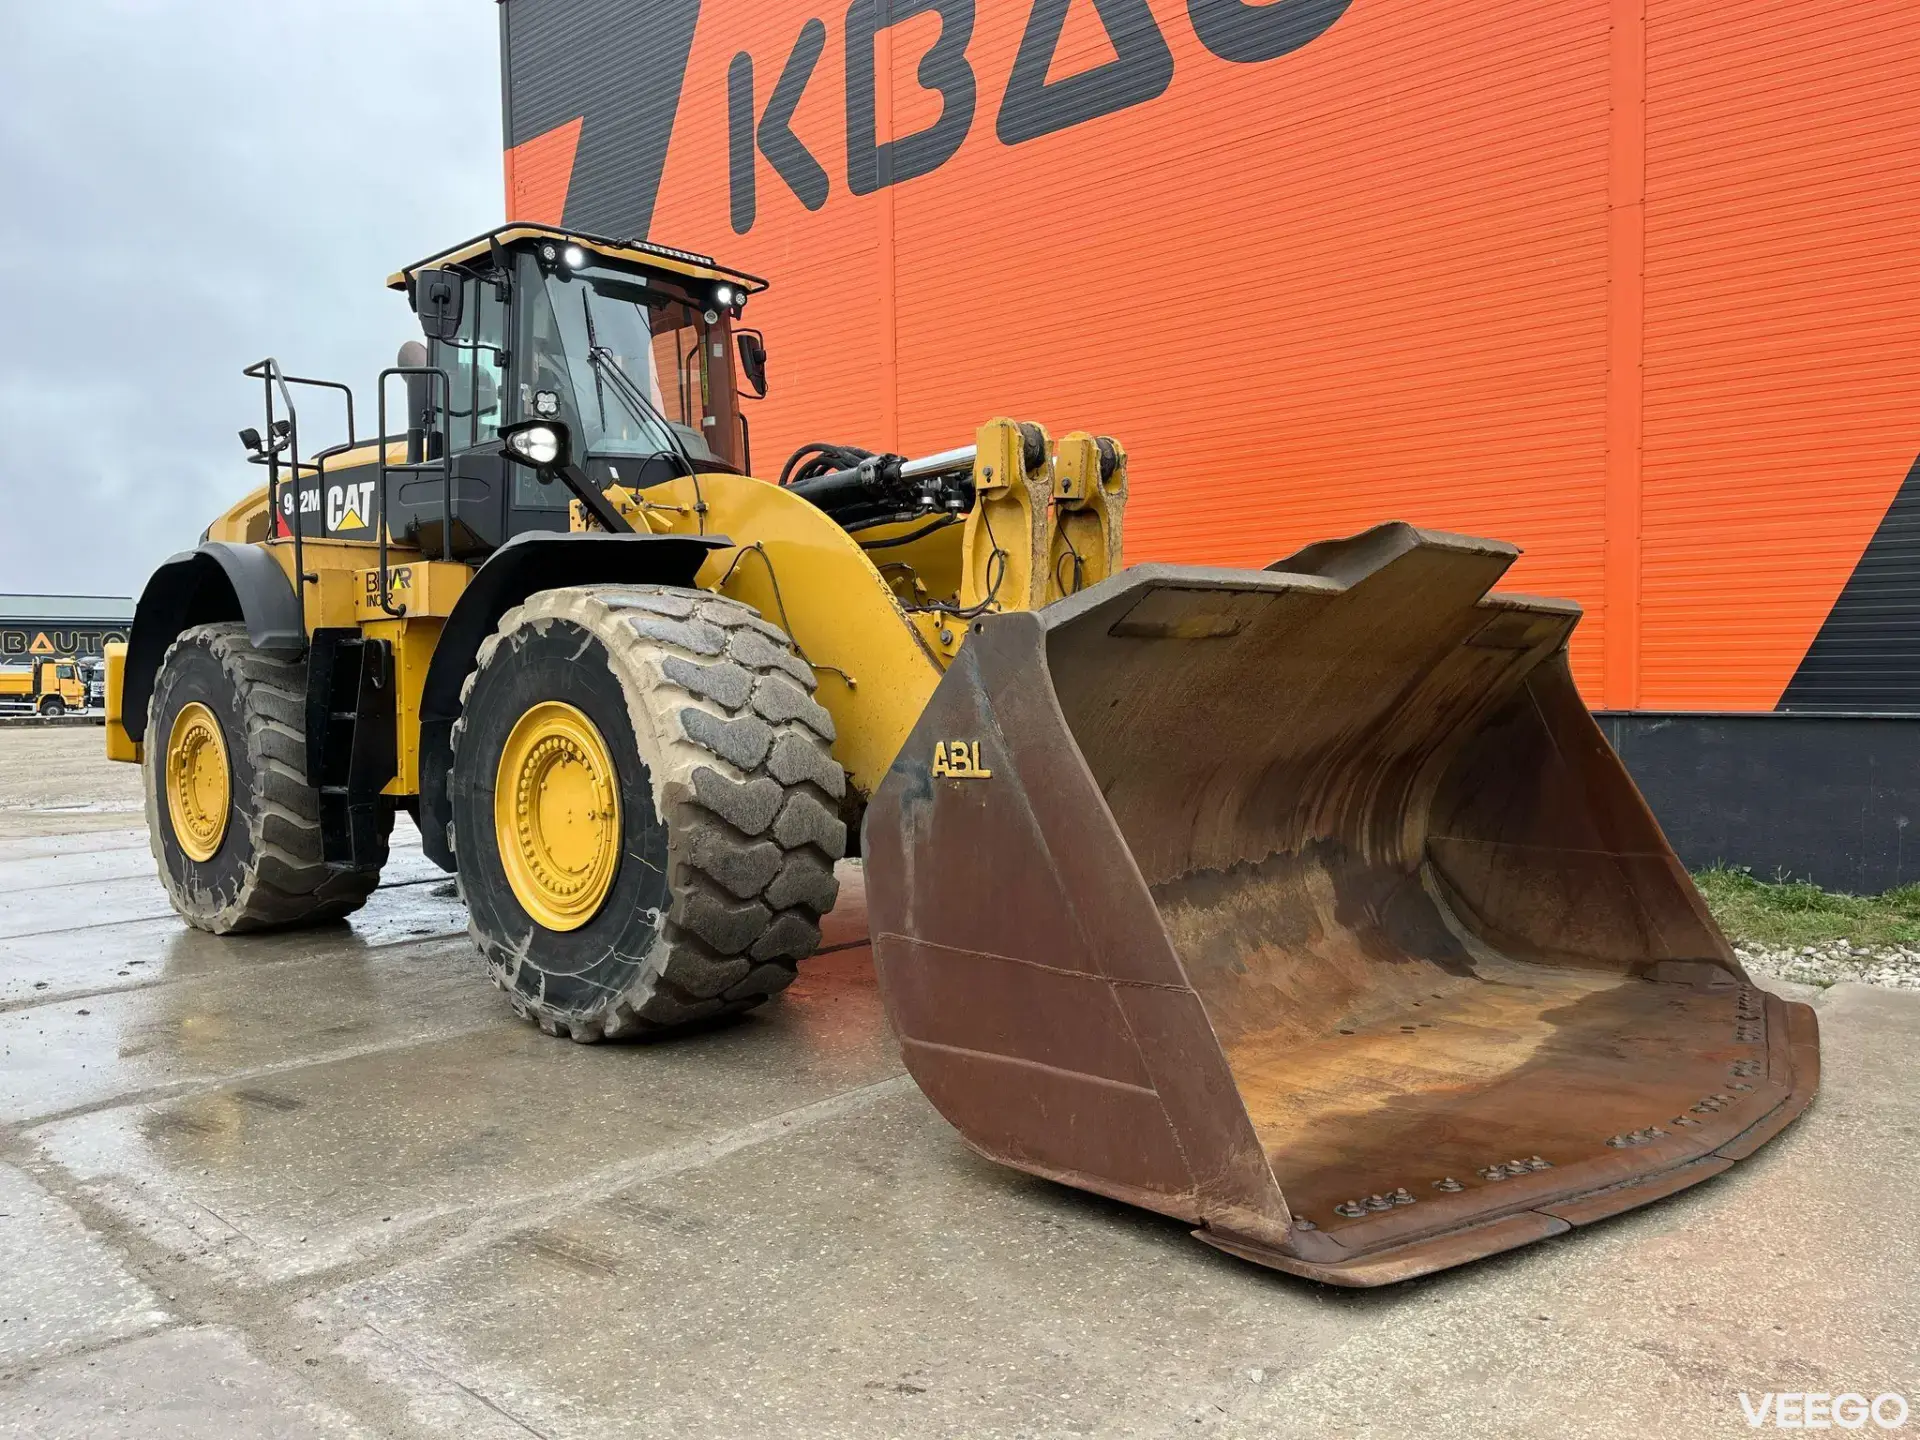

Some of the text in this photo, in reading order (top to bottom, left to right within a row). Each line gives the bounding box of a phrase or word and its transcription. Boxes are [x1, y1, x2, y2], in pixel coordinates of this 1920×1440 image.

[727, 0, 1355, 235] KBA
[284, 489, 320, 515] 92M
[327, 481, 375, 532] CAT
[932, 740, 992, 778] ABL
